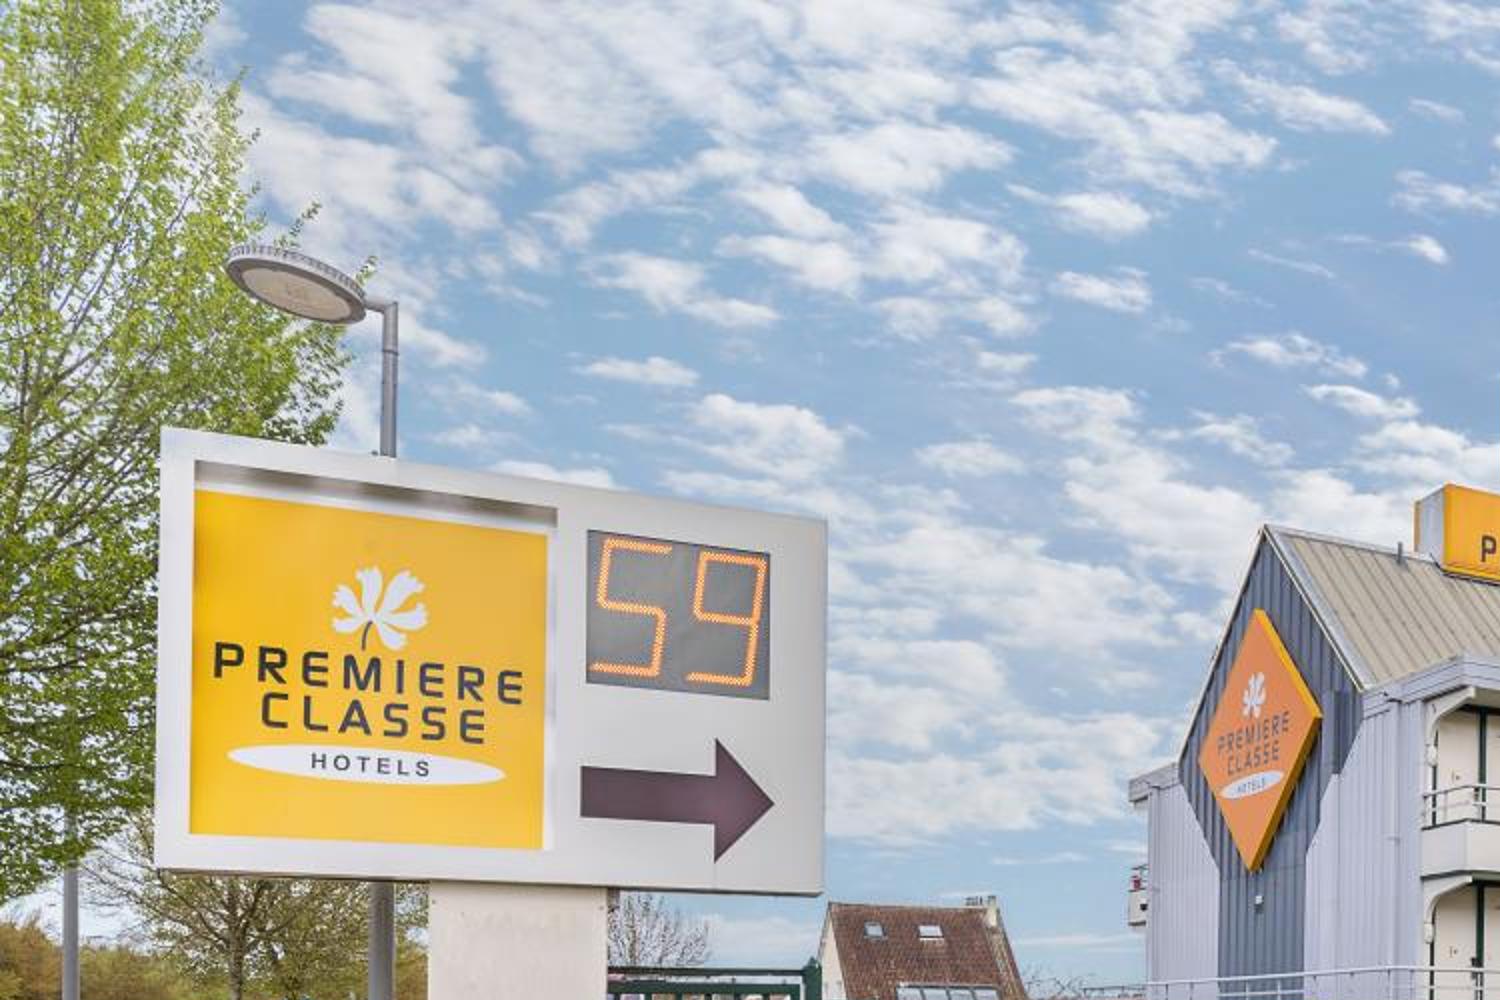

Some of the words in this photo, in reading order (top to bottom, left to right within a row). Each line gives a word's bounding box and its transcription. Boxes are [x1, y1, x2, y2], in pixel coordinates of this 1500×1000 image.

[590, 538, 768, 687] 59
[213, 642, 523, 705] PREMIERE
[261, 692, 485, 744] CLASSE
[1217, 710, 1290, 756] PREMIERE
[311, 752, 430, 777] HOTELS
[1228, 739, 1280, 775] CLASSE
